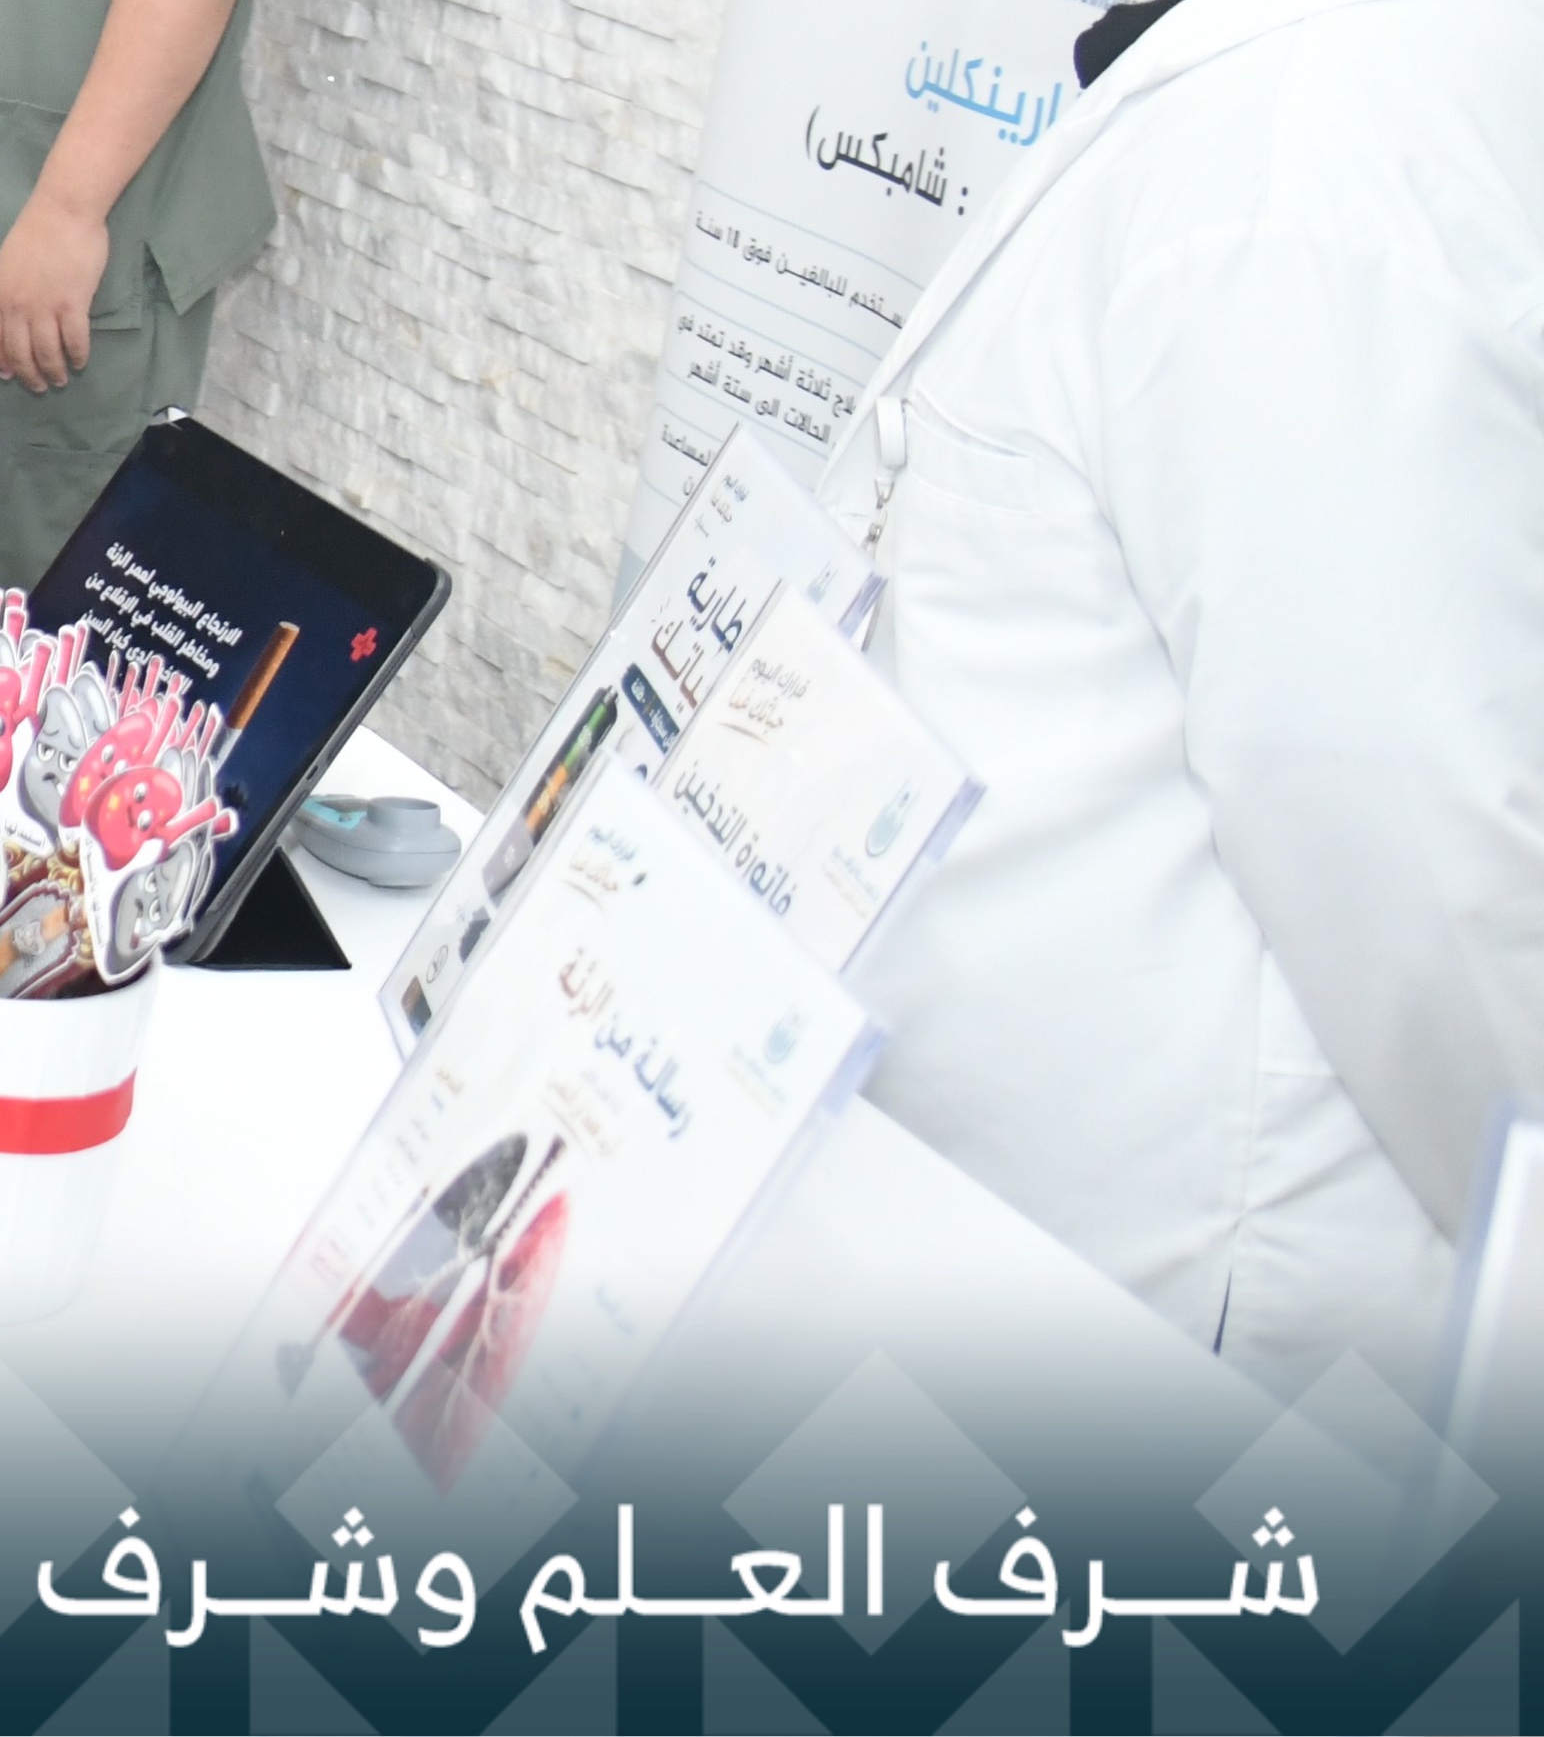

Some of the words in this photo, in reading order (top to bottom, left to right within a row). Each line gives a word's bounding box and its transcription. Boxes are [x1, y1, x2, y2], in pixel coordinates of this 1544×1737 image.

[905, 40, 1064, 147] ارينكلين
[849, 291, 907, 330] ستخدم
[84, 572, 106, 589] عن
[129, 609, 156, 628] في
[686, 556, 742, 654] طارية
[176, 638, 221, 679] ومخاطر
